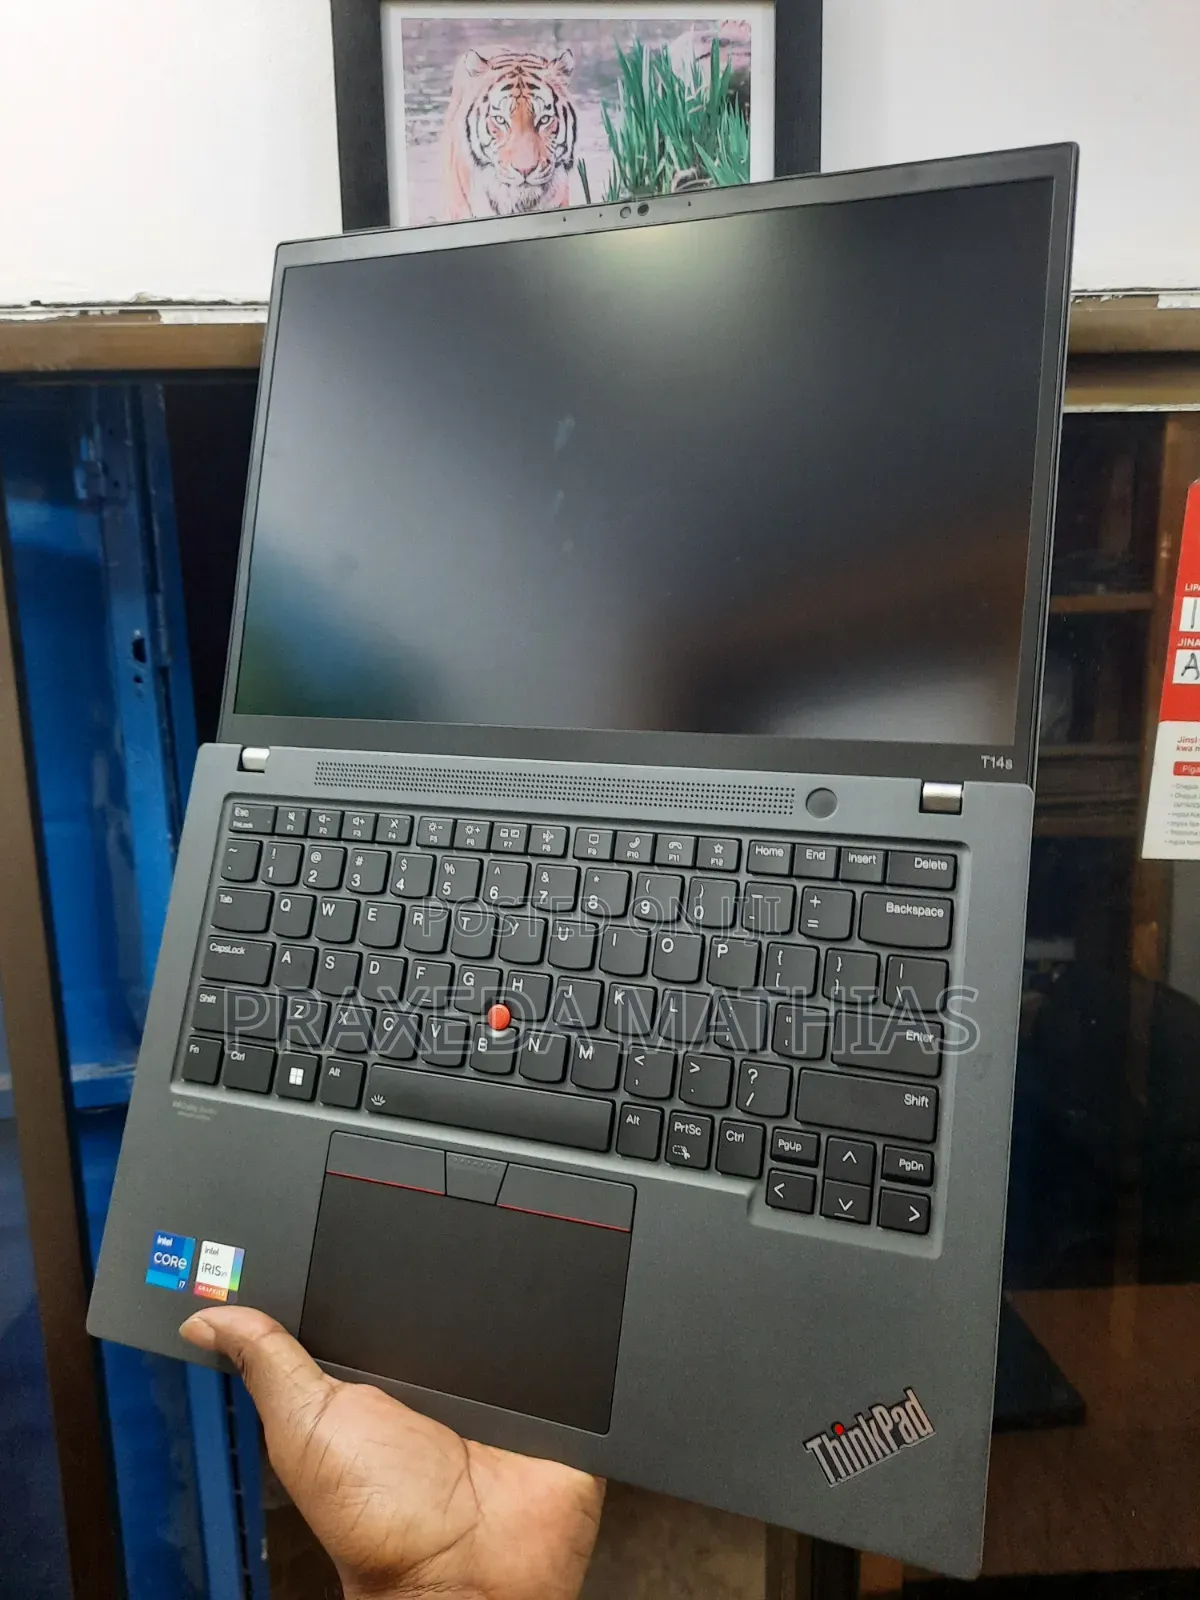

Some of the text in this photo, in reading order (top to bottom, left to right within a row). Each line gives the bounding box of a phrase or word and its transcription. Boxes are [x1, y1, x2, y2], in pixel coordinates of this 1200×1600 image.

[310, 851, 322, 864] @
[626, 850, 640, 859] F10
[668, 853, 680, 862] F11
[755, 845, 785, 857] Home
[805, 848, 826, 861] End
[848, 851, 877, 865] Insert
[914, 856, 948, 871] Delete
[267, 865, 274, 878] 1
[307, 869, 318, 883] 2
[351, 873, 361, 887] 3
[395, 877, 405, 891] 4
[442, 881, 452, 896] 5
[489, 885, 499, 900] 6
[219, 894, 233, 904] Tab
[539, 890, 549, 905] 7
[588, 894, 598, 910] 8
[280, 898, 292, 912] Q
[321, 902, 335, 918] W
[640, 899, 650, 915] 9
[694, 904, 704, 920] 0
[885, 901, 945, 918] Backspace
[367, 908, 378, 922] E
[412, 913, 424, 926] R
[461, 917, 471, 931] T
[510, 921, 520, 936] Y
[558, 926, 570, 942] U
[209, 942, 246, 955] CapsLock
[661, 937, 675, 953] O
[717, 943, 729, 959] P
[281, 950, 291, 964] A
[324, 955, 335, 970] S
[369, 960, 380, 975] D
[415, 967, 426, 980] F
[462, 971, 475, 987] G
[511, 978, 524, 993] H
[199, 993, 217, 1004] Shift
[563, 984, 573, 999] J
[614, 990, 625, 1006] K
[293, 1004, 305, 1019] Z
[669, 997, 679, 1013] L
[338, 1011, 349, 1025] X
[382, 1017, 394, 1031] C
[431, 1024, 442, 1038] V
[905, 1029, 934, 1043] Enter
[189, 1043, 200, 1054] Fn
[477, 1037, 488, 1052] B
[528, 1037, 540, 1053] N
[230, 1050, 246, 1062] Ctrl
[578, 1045, 594, 1061] M
[328, 1066, 341, 1077] Alt
[747, 1068, 758, 1085] ?
[903, 1093, 930, 1108] Shift
[626, 1113, 641, 1127] Alt
[674, 1121, 702, 1137] PrtSc
[725, 1129, 745, 1143] Ctrl
[778, 1138, 803, 1152] PgUp
[898, 1157, 924, 1173] PgDn
[204, 1246, 219, 1256] intel
[803, 1387, 936, 1487] ThinkPad
